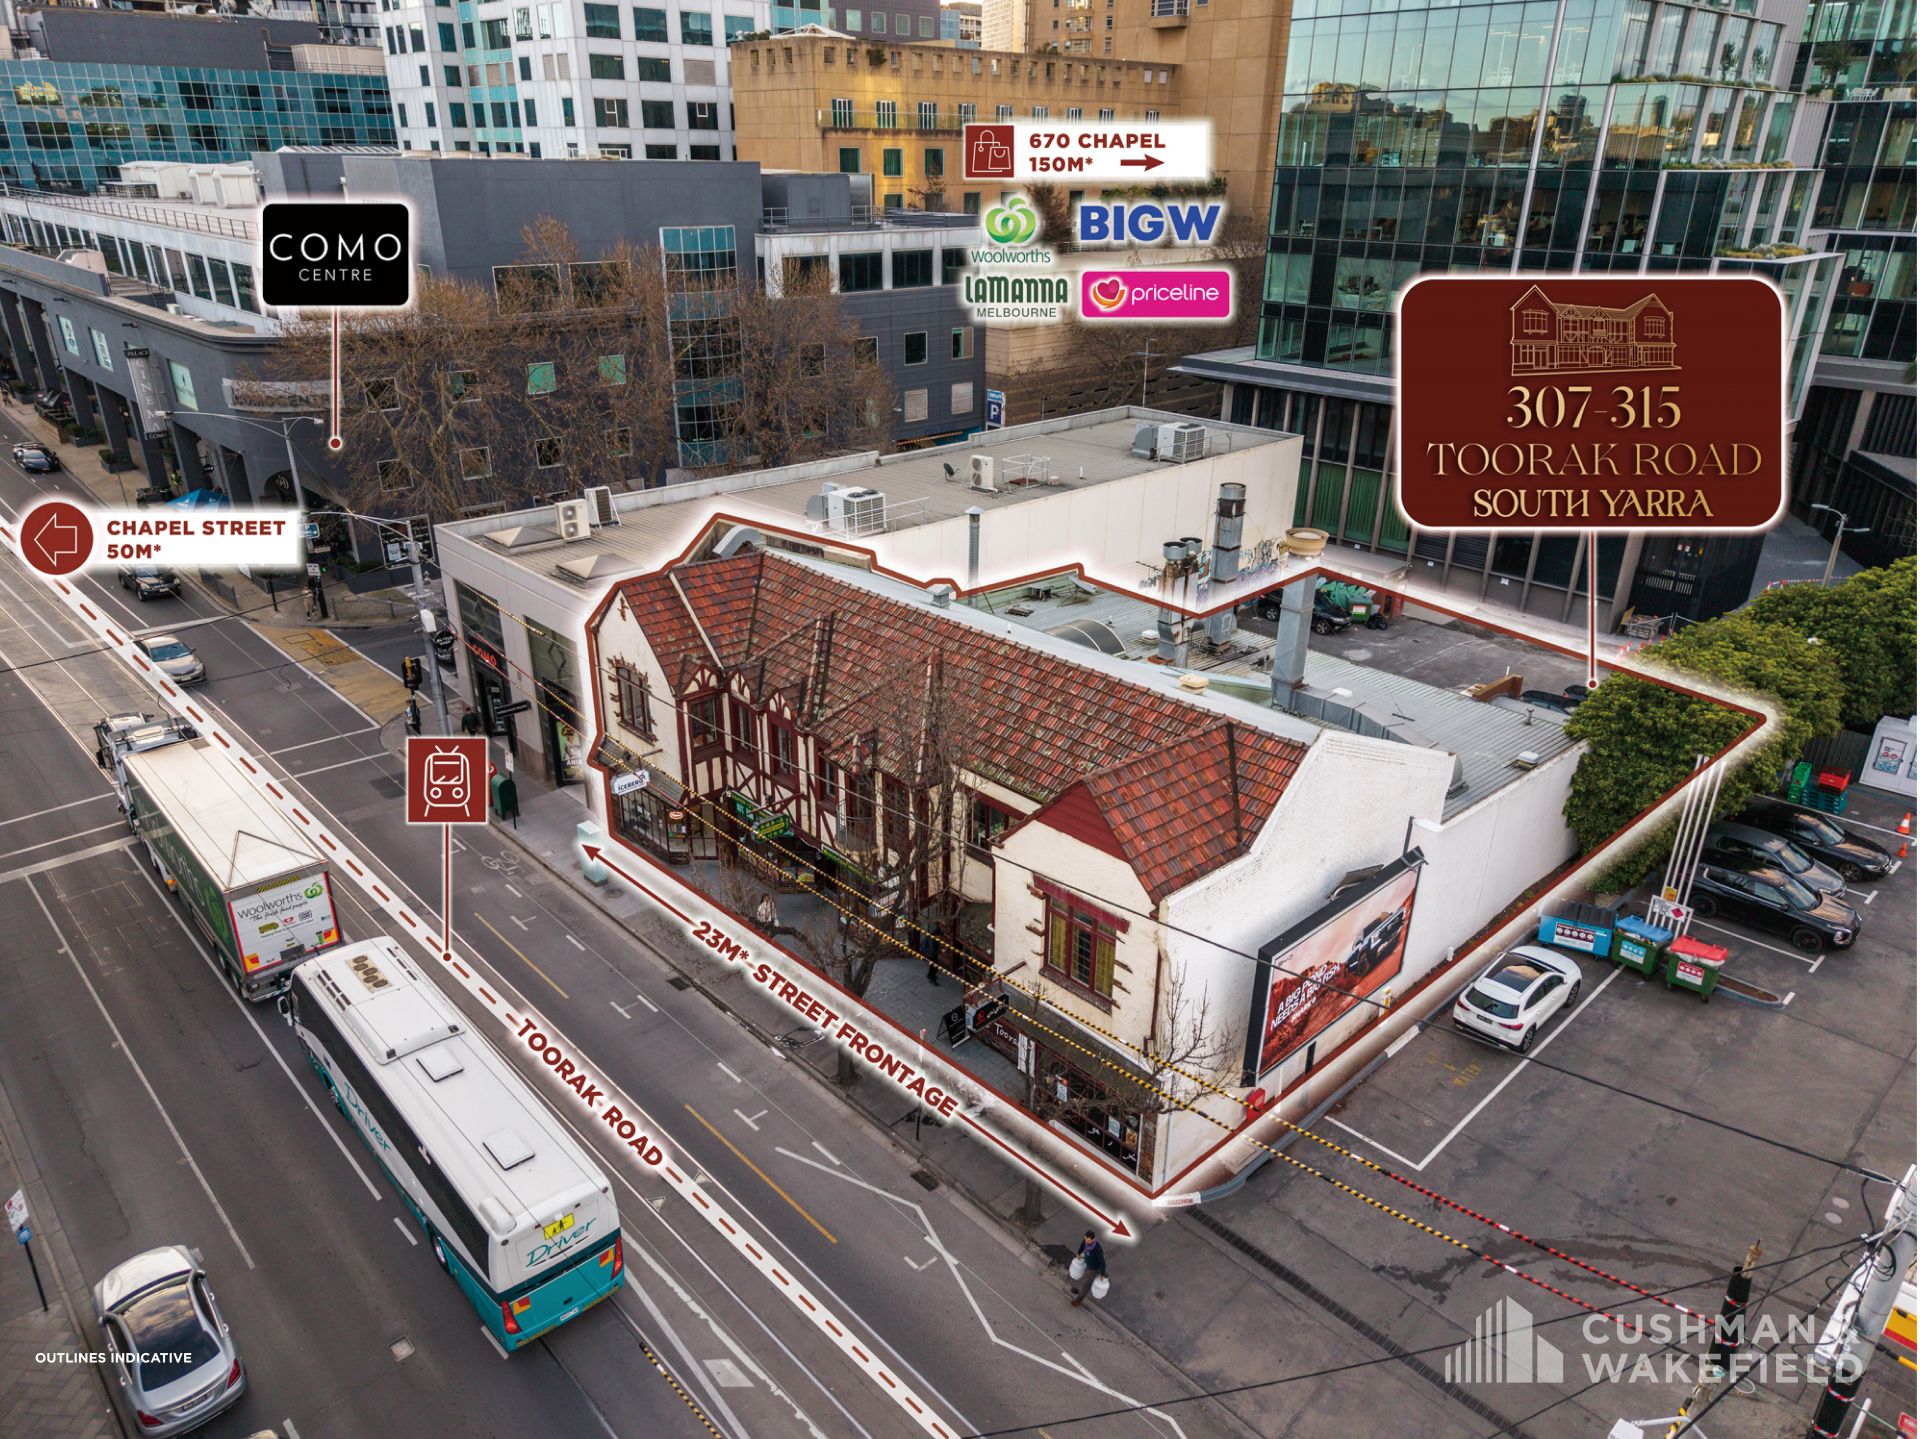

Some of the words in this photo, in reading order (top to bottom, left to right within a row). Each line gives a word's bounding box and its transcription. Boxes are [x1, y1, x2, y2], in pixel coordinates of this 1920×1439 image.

[990, 404, 999, 419] P
[238, 892, 303, 919] Woolworths
[1270, 1001, 1299, 1031] NEEDS
[525, 1217, 597, 1268] Driver
